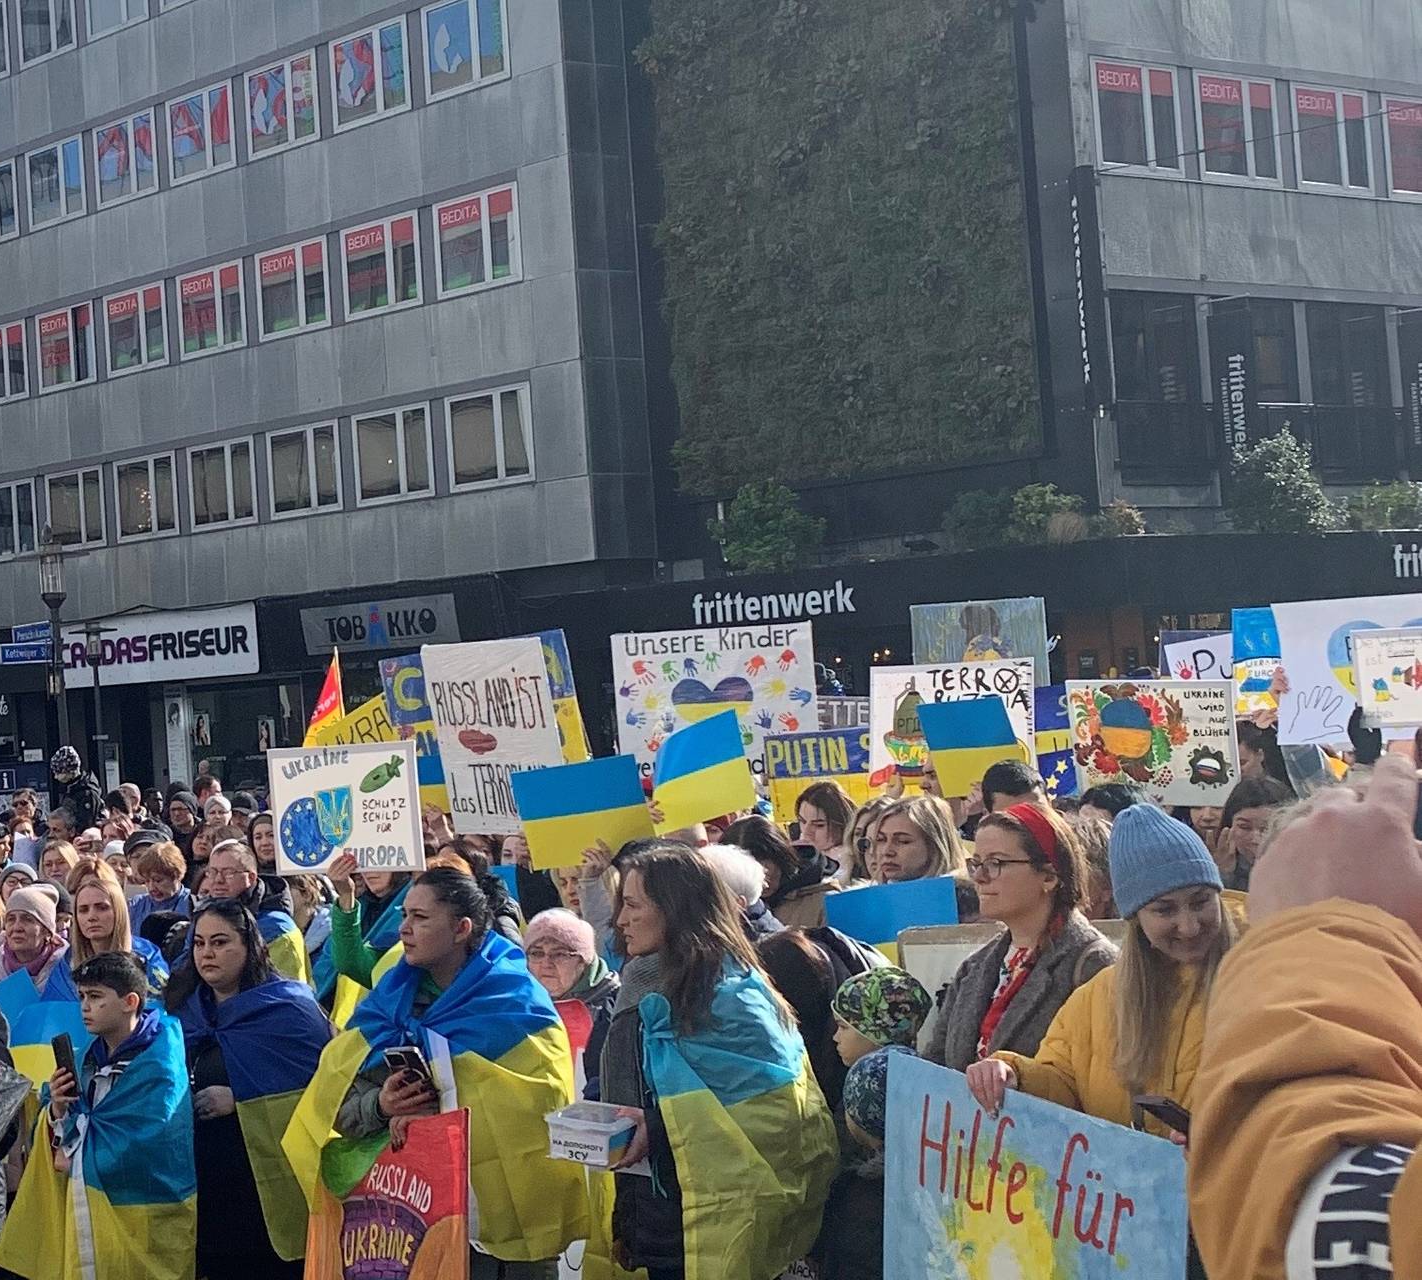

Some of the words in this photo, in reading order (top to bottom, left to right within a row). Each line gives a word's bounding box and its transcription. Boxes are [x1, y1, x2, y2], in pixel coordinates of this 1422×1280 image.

[1098, 69, 1139, 88] BEDITA
[1201, 82, 1240, 101] BEDITA
[1297, 94, 1335, 112] BEDITA
[441, 204, 480, 226] BEDITA
[347, 231, 384, 251] BEDITA
[261, 255, 295, 274] BEDITA
[182, 278, 213, 295] BEDITA
[109, 298, 138, 316] BEDITA
[41, 317, 68, 333] BEDITA
[1227, 353, 1248, 449] frittenwe
[692, 580, 857, 625] frittenwerk
[431, 677, 516, 729] RUSSLAND
[1193, 726, 1230, 737] BLÜHEN
[767, 736, 849, 778] PUTIN
[362, 798, 406, 809] SCHUTZ
[918, 1093, 1028, 1226] Hilfe
[1052, 1132, 1135, 1255] für
[366, 1162, 433, 1214] RUSSLAND
